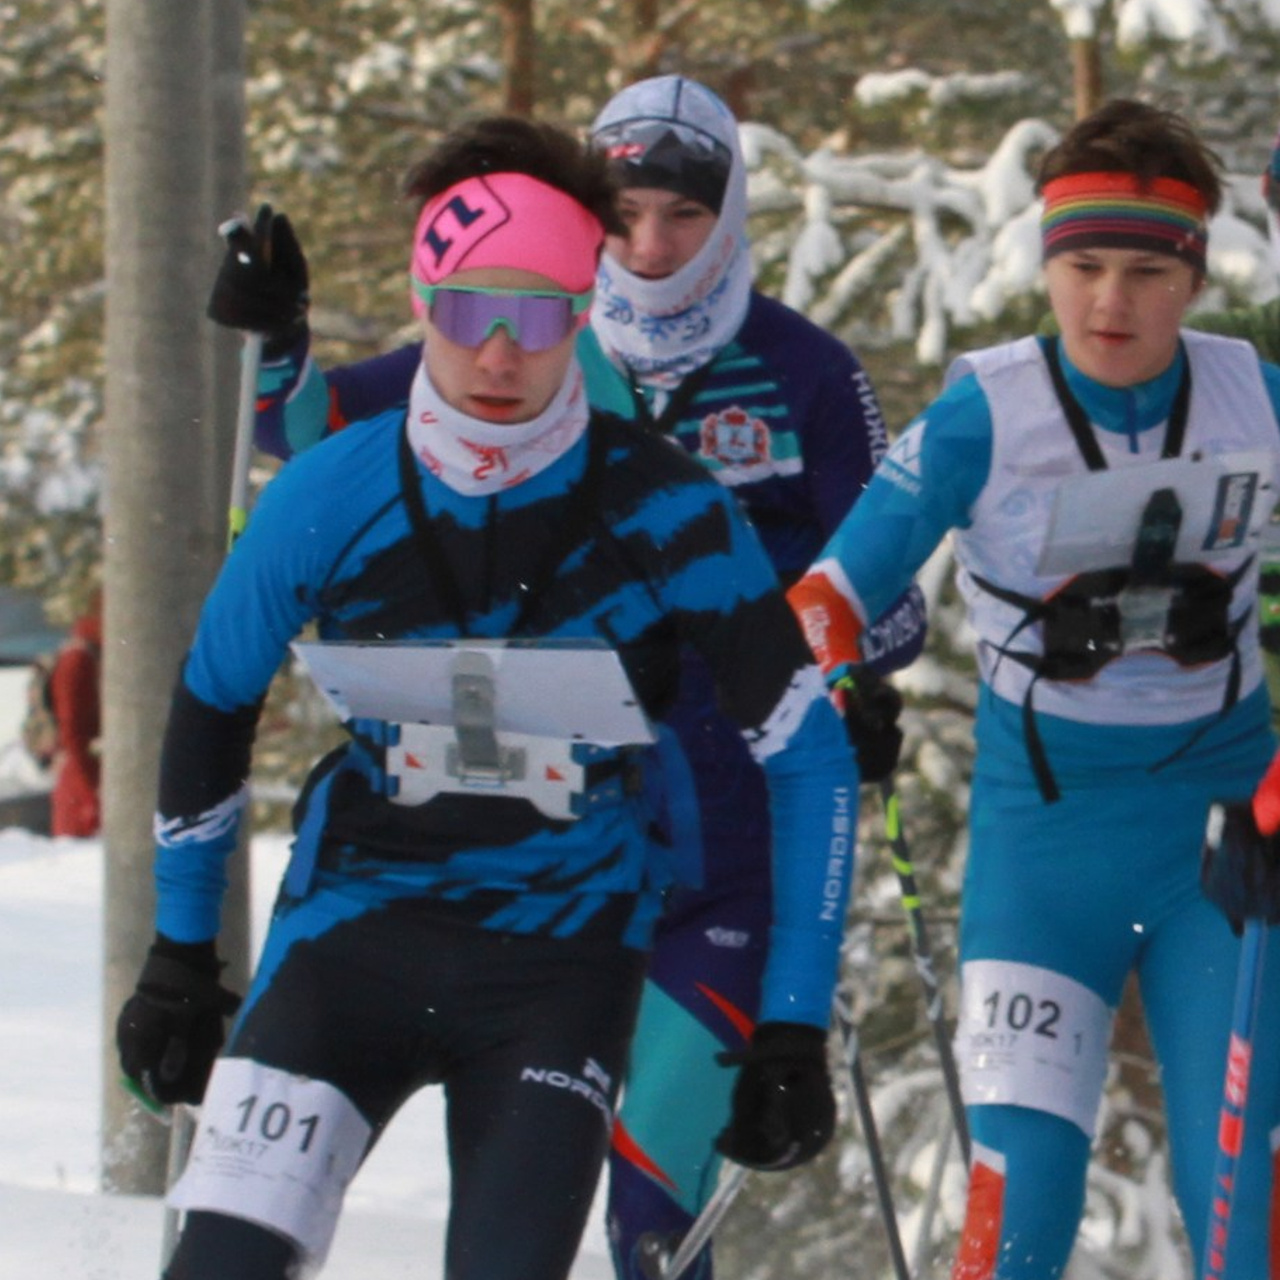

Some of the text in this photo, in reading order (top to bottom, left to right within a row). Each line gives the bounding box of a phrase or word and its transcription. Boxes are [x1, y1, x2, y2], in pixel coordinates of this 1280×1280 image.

[818, 786, 849, 922] NORDSKI
[984, 989, 1062, 1040] 102
[237, 1093, 320, 1154] 101
